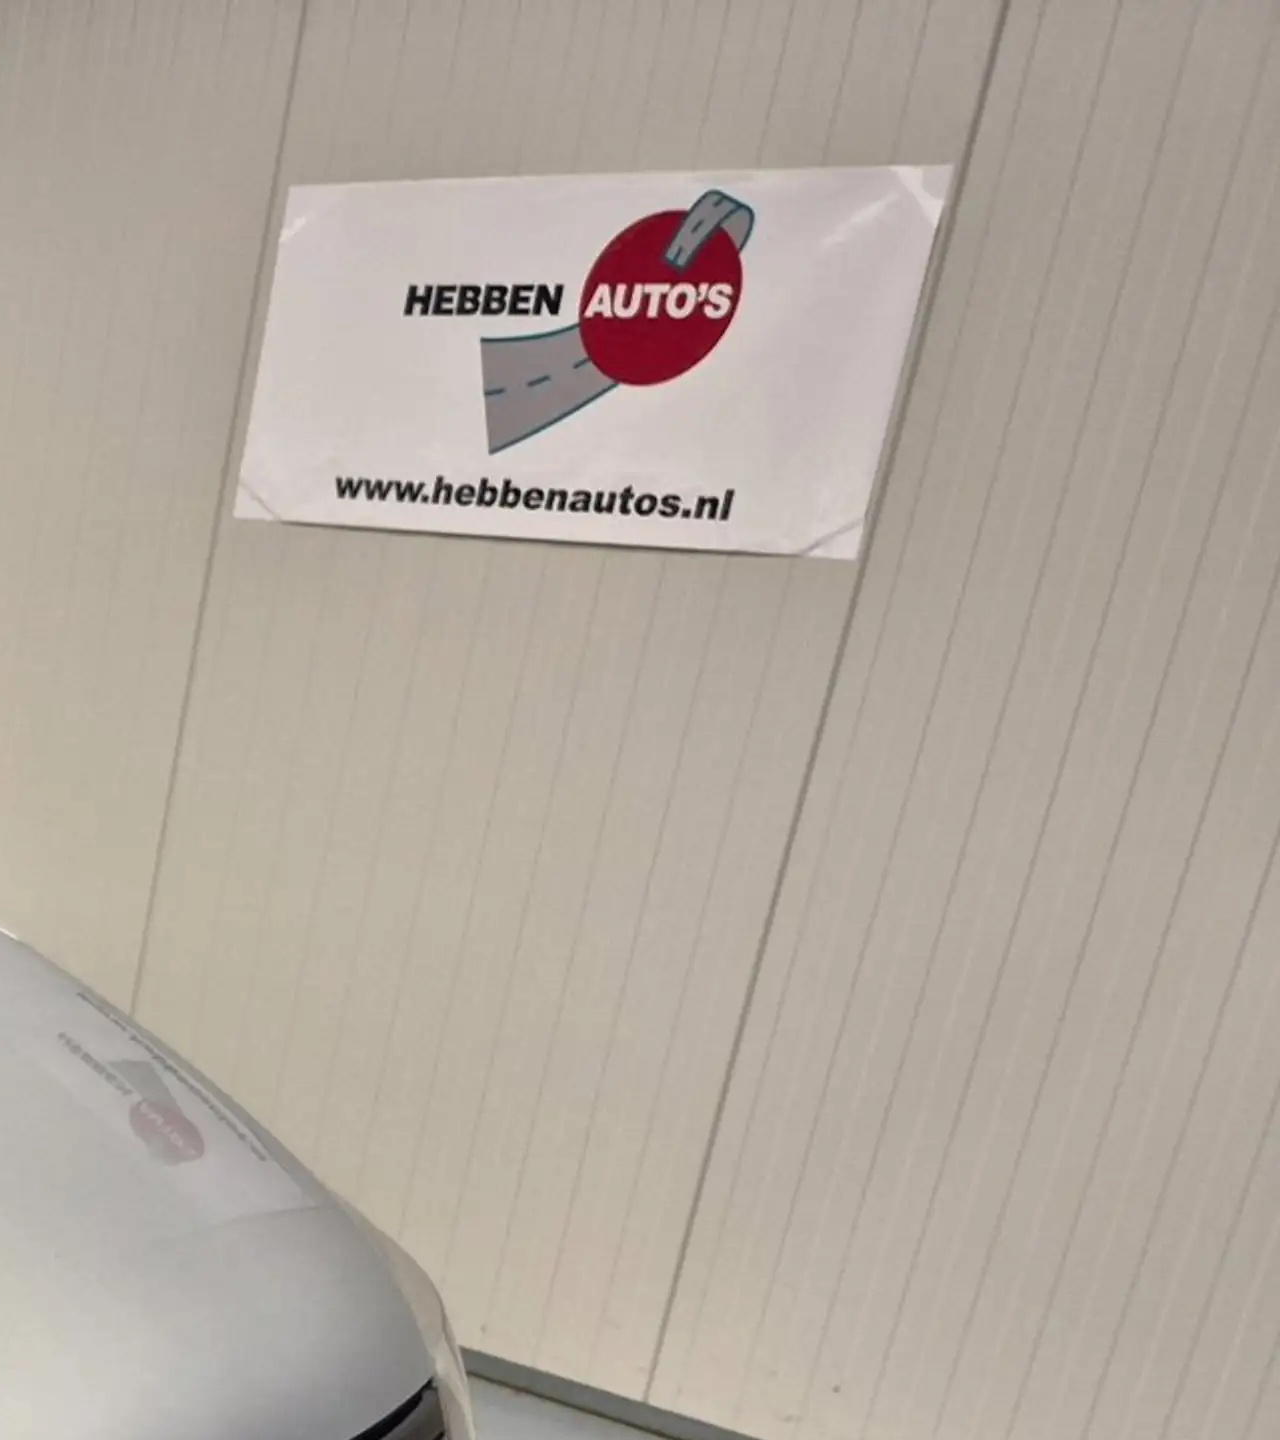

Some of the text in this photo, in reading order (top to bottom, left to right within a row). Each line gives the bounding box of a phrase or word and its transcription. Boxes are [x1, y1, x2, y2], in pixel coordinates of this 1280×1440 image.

[403, 281, 734, 321] HEBBEN AUTO'S
[334, 474, 736, 522] www.hebbenautos.nl
